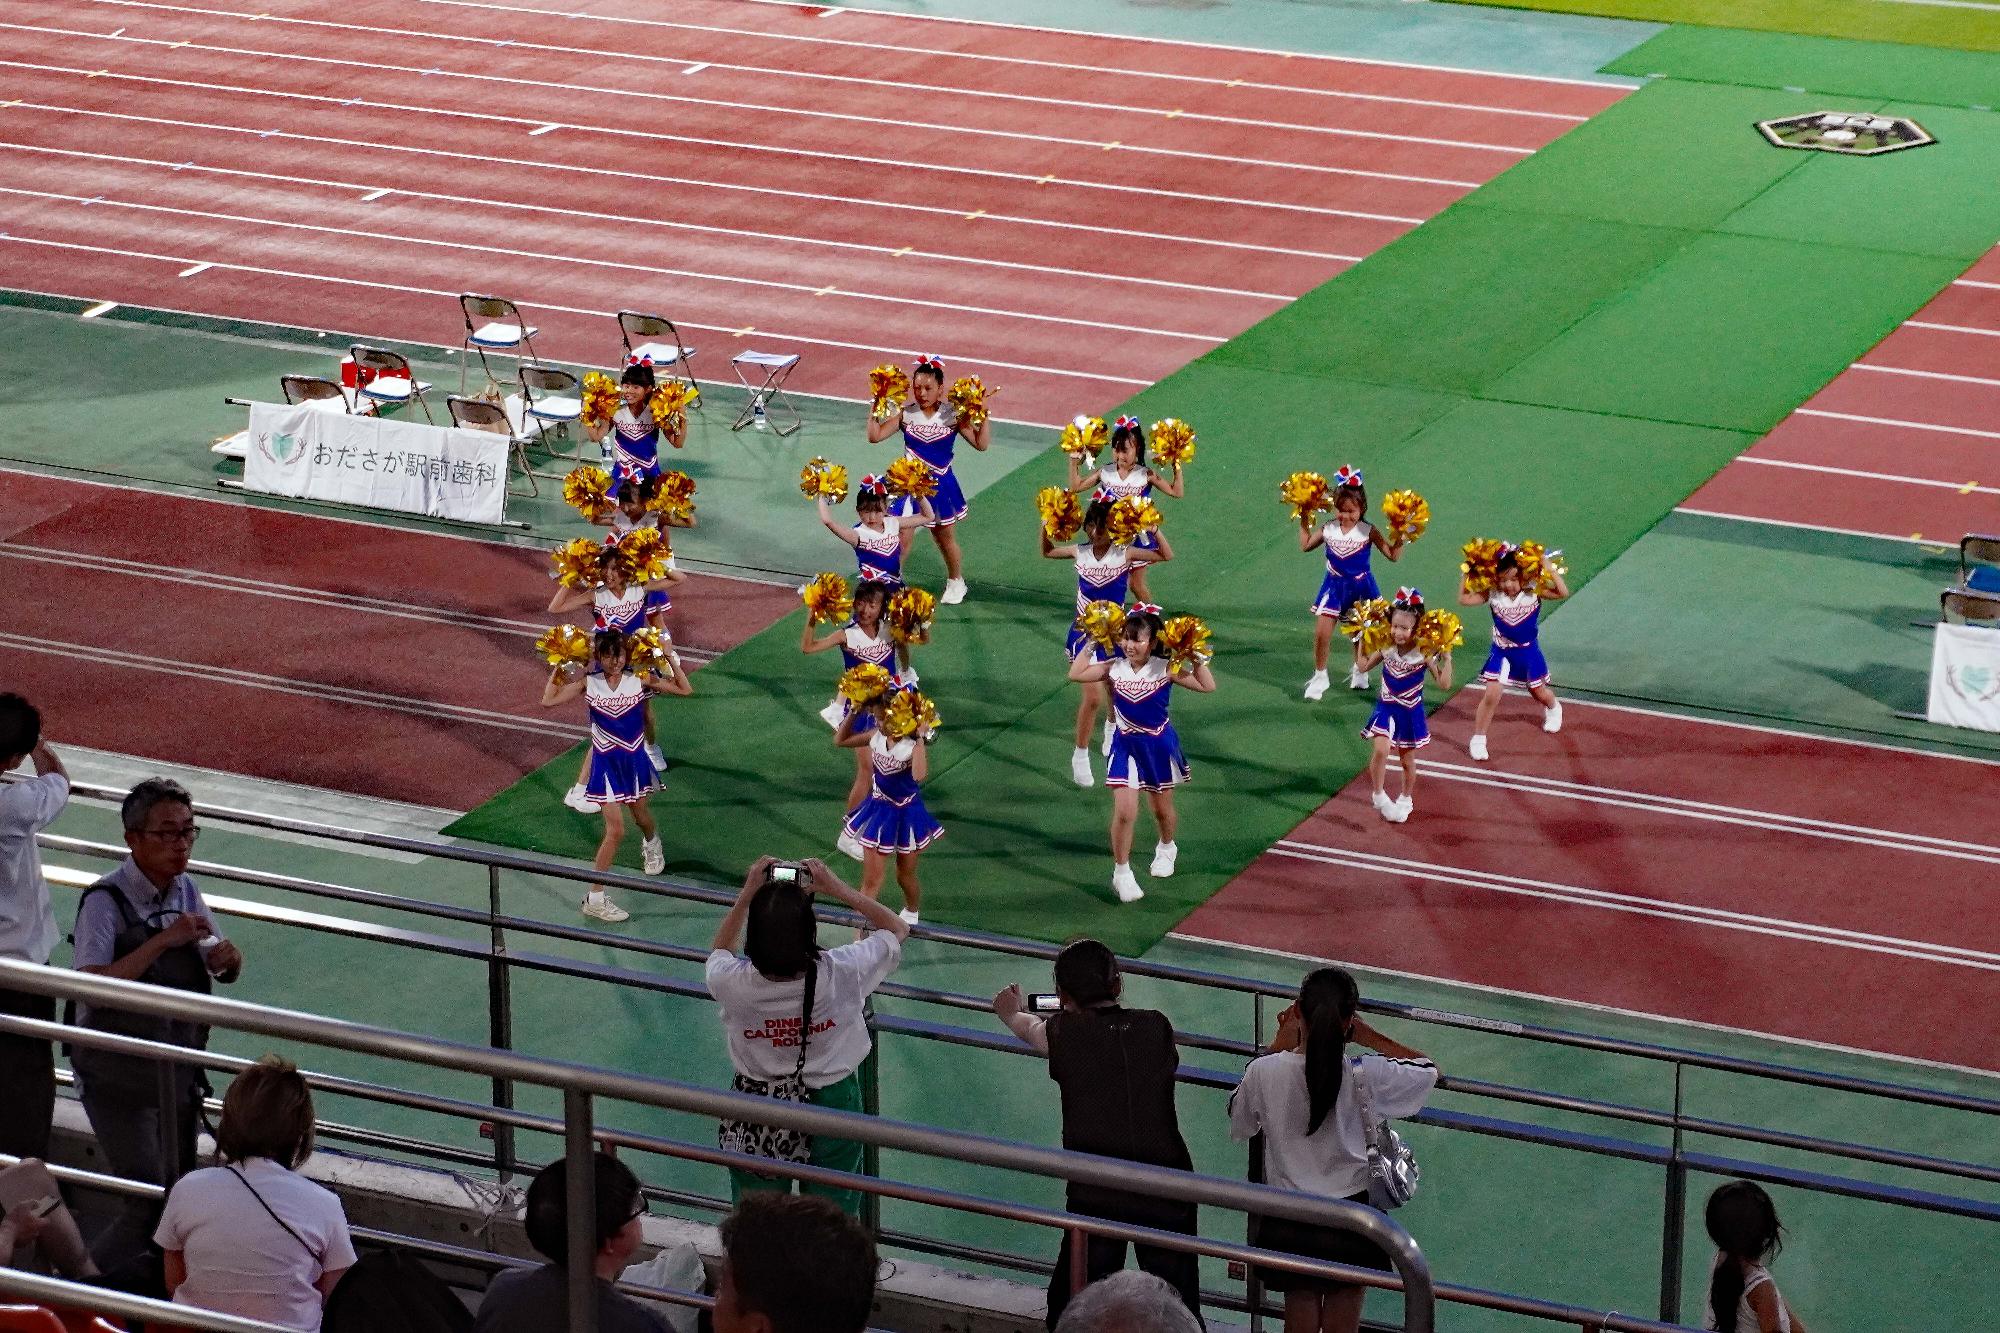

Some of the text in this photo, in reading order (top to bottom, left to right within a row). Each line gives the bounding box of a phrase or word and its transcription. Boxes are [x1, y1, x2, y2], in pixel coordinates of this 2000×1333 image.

[313, 442, 497, 488] おださが駅前歯科
[743, 1018, 837, 1040] CALIFONIA
[764, 1016, 812, 1028] DINE
